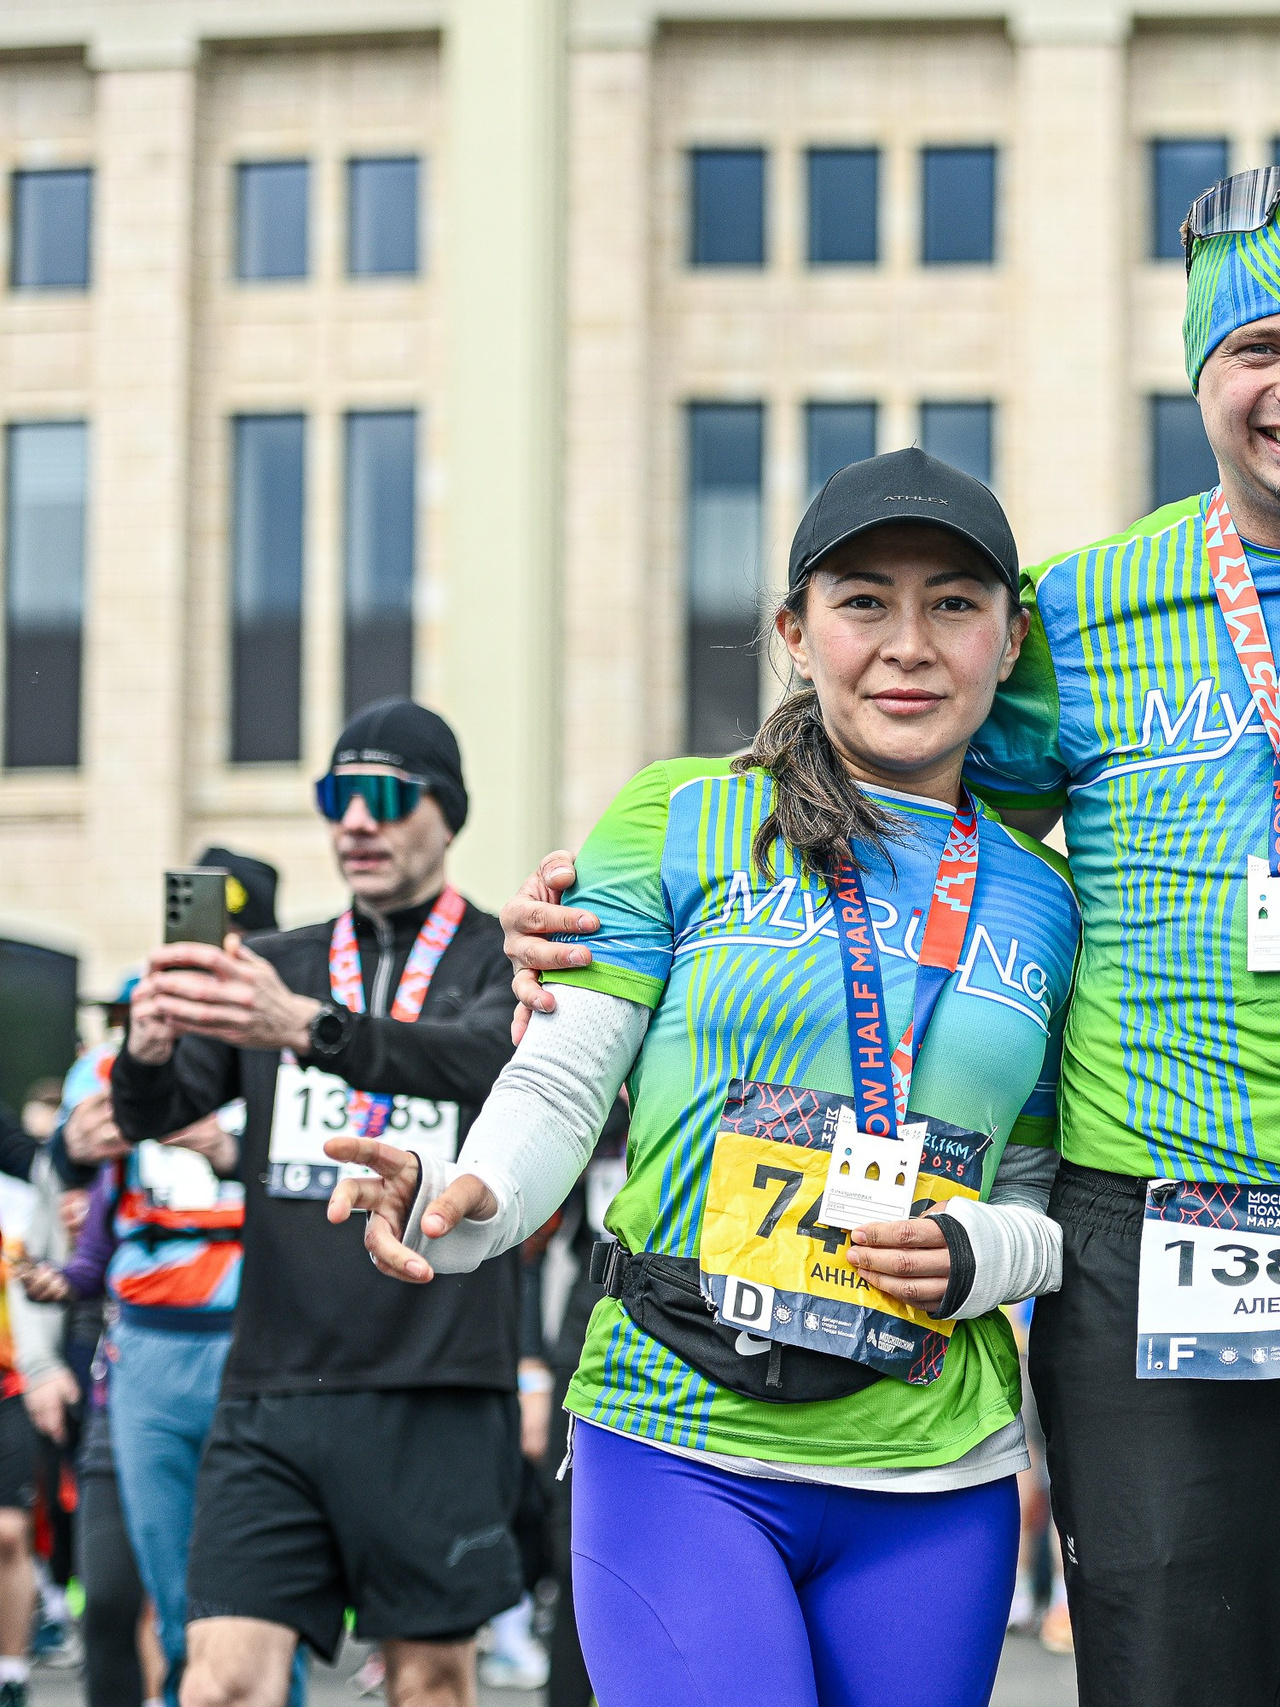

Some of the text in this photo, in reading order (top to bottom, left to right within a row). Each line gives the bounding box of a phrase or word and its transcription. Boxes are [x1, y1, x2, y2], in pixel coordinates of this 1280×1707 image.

[852, 980, 885, 1069] HALF
[811, 1263, 870, 1292] АННА
[732, 1281, 763, 1322] D
[1168, 1337, 1198, 1371] F
